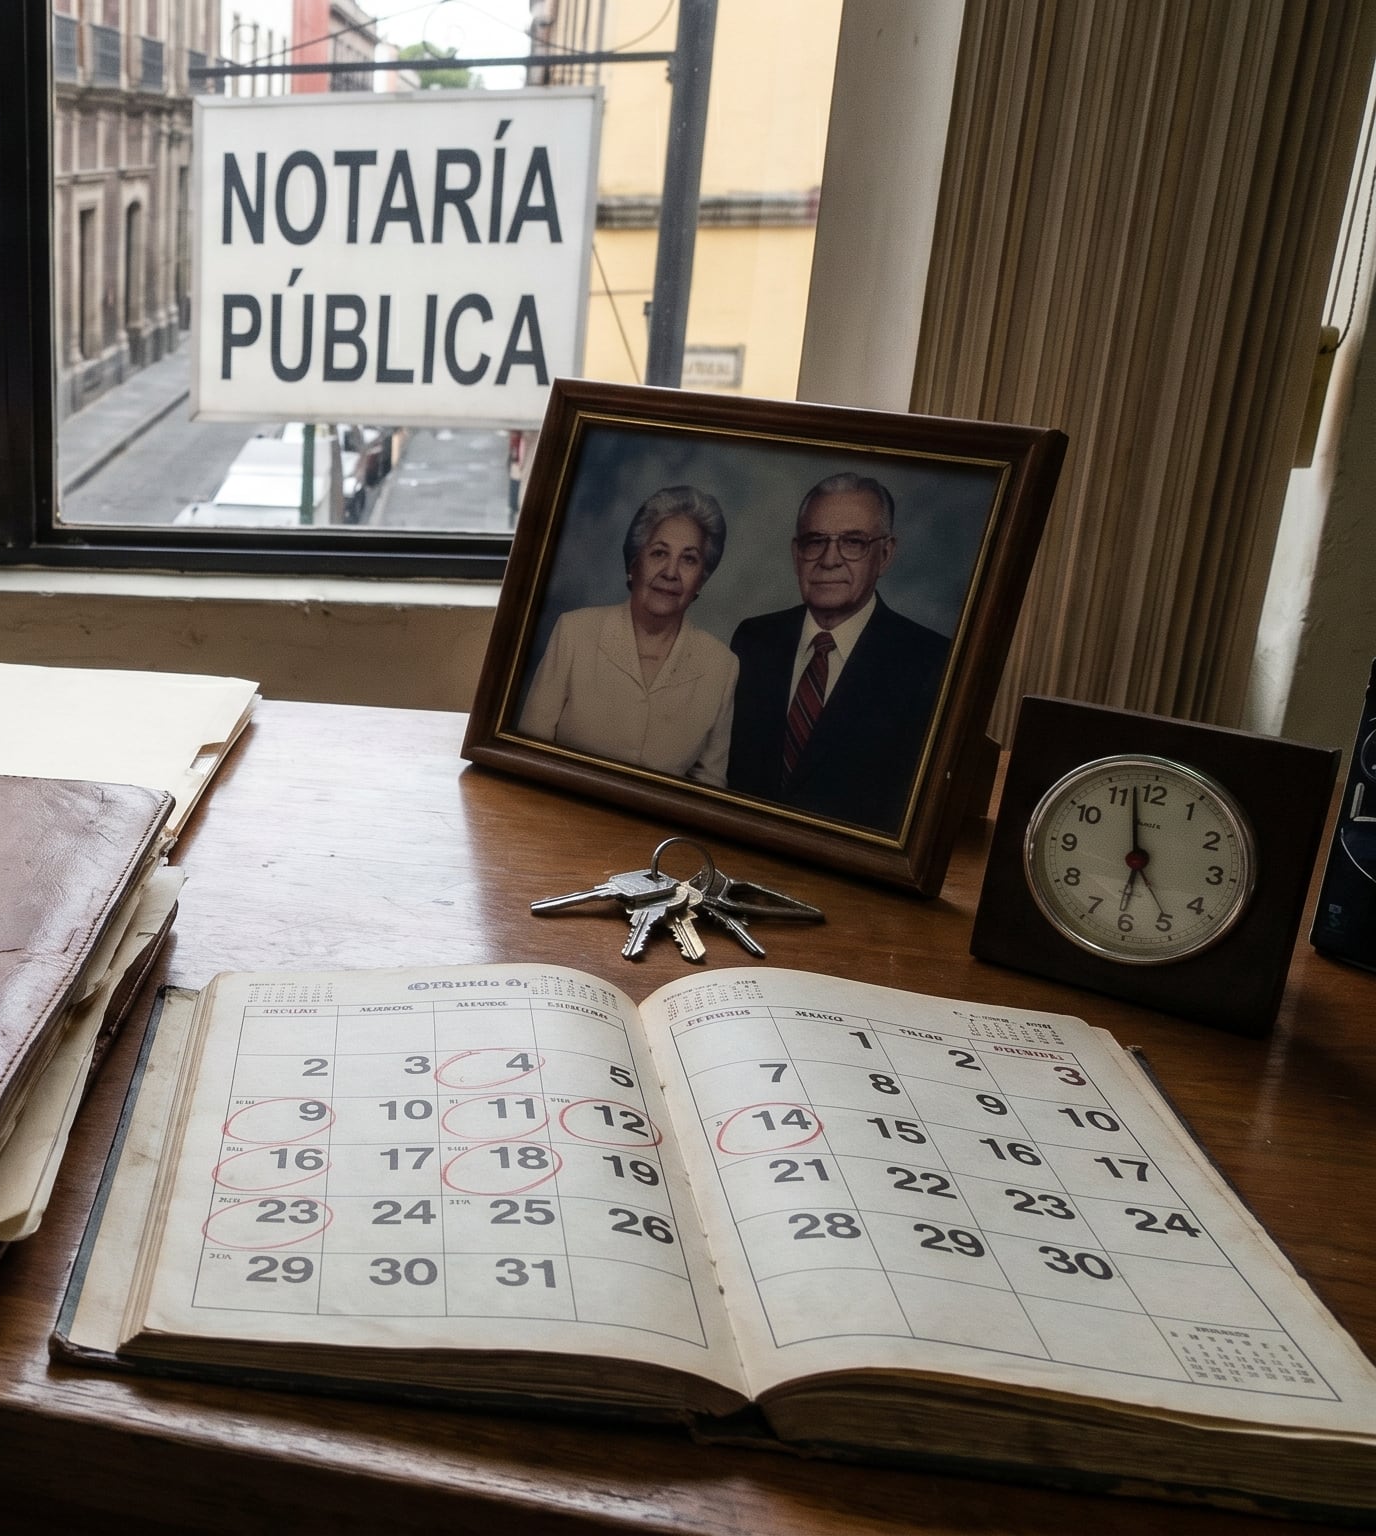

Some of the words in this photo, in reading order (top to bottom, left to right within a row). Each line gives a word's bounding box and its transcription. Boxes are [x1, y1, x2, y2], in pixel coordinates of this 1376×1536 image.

[222, 119, 563, 246] NOTARÍA
[221, 268, 550, 386] PÚBLICA
[1108, 786, 1129, 807] 11
[1142, 783, 1168, 806] 12
[1077, 804, 1102, 825] 10
[1186, 803, 1196, 821] 1
[1061, 833, 1078, 851] 9
[1202, 831, 1221, 851] 2
[1063, 867, 1081, 886] 8
[1205, 866, 1224, 885] 3
[1087, 896, 1104, 914] 7
[1186, 897, 1205, 915] 4
[1117, 914, 1134, 932] 6
[1155, 913, 1173, 932] 5
[301, 1057, 328, 1077] 2
[403, 1055, 431, 1075] 3
[505, 1052, 534, 1073] 4
[609, 1065, 634, 1088] 5
[848, 1031, 872, 1049] 1
[947, 1049, 982, 1071] 2
[1053, 1066, 1087, 1086] 3
[759, 1062, 788, 1083] 7
[868, 1072, 901, 1095] 8
[975, 1093, 1008, 1116] 9
[1057, 1107, 1120, 1132] 10
[298, 1099, 327, 1121] 9
[378, 1099, 433, 1120] 10
[487, 1097, 536, 1119] 11
[593, 1104, 649, 1137] 12
[751, 1108, 813, 1131] 14
[866, 1116, 927, 1145] 15
[978, 1137, 1042, 1166] 16
[1093, 1156, 1150, 1183] 17
[269, 1147, 324, 1170] 16
[379, 1147, 435, 1170] 17
[489, 1146, 549, 1170] 18
[602, 1154, 660, 1187] 19
[768, 1158, 830, 1184] 21
[885, 1166, 958, 1200] 22
[1004, 1188, 1076, 1220] 23
[1124, 1207, 1202, 1239] 24
[255, 1198, 319, 1224] 23
[371, 1199, 436, 1225] 24
[489, 1199, 555, 1225] 25
[609, 1207, 675, 1245] 26
[787, 1212, 862, 1241] 28
[912, 1223, 986, 1258] 29
[1037, 1245, 1114, 1281] 30
[245, 1255, 314, 1284] 29
[368, 1257, 438, 1286] 30
[494, 1257, 557, 1289] 31
